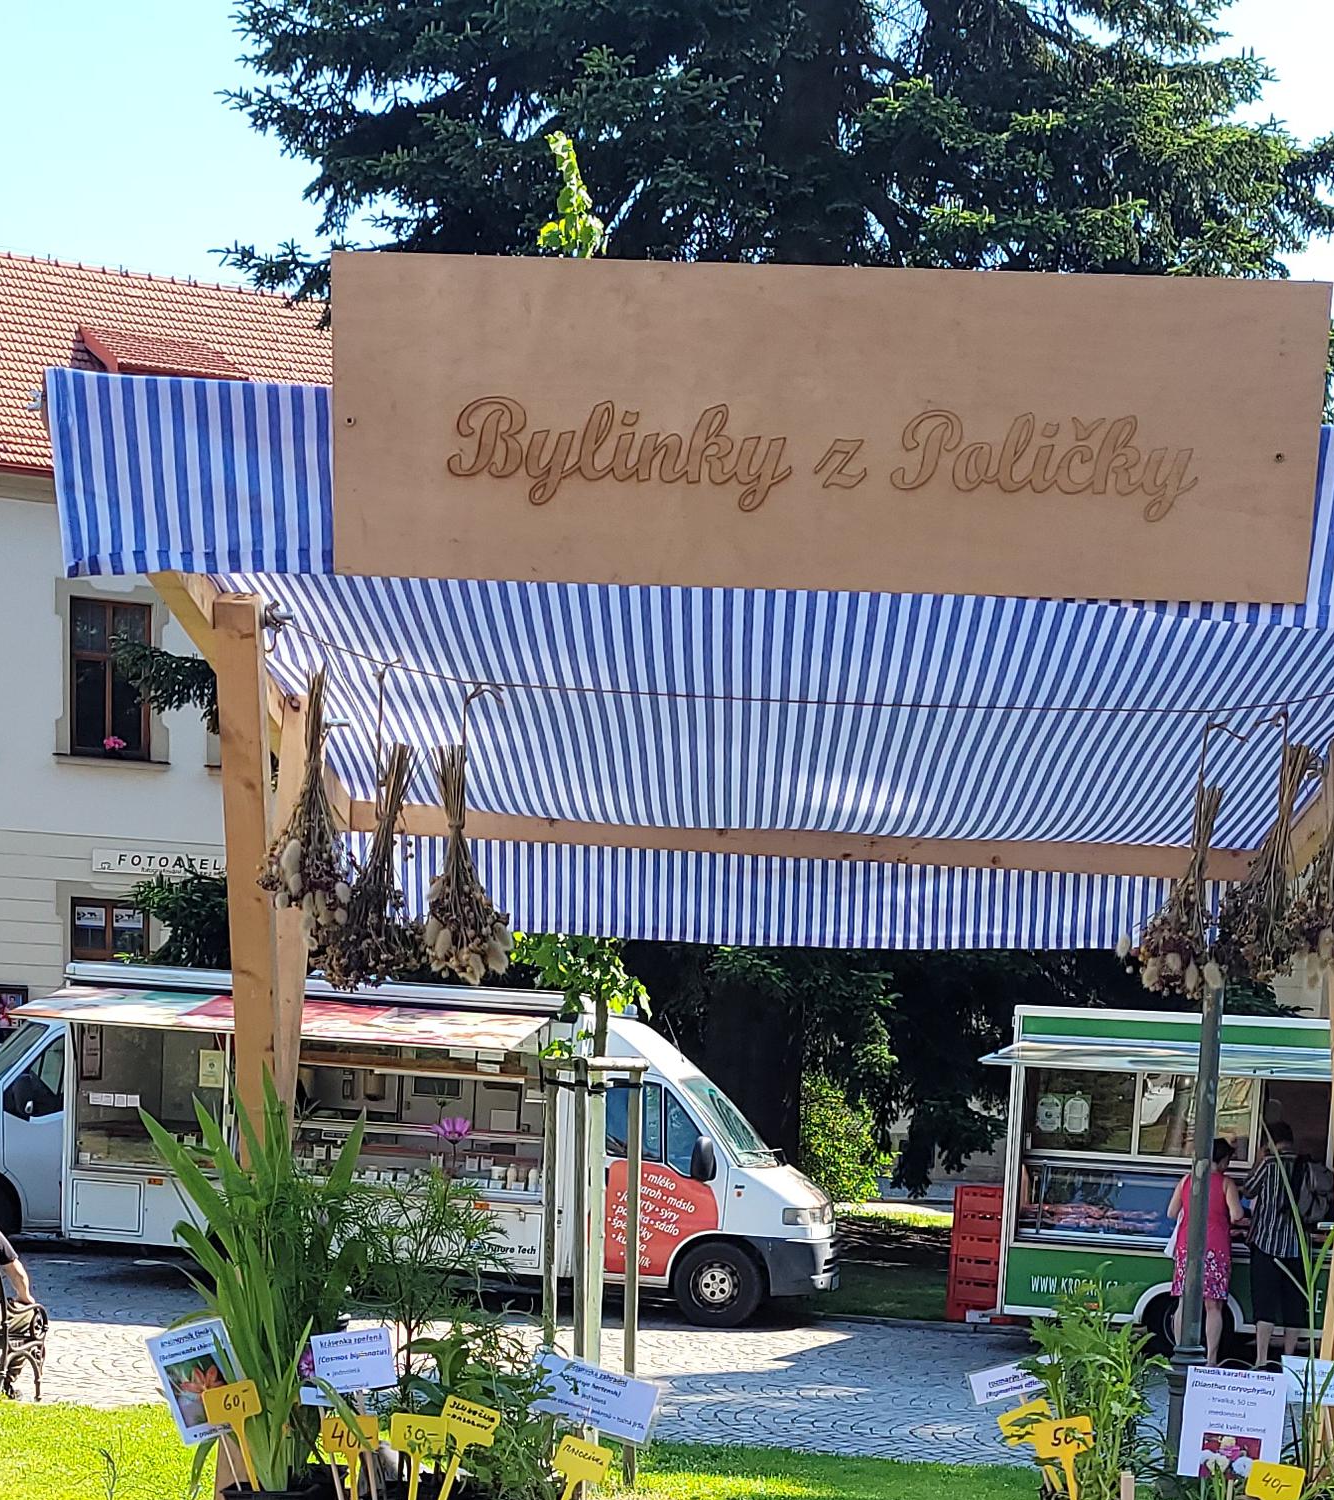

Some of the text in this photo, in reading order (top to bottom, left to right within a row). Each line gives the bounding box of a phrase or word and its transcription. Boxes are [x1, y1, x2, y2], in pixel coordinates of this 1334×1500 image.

[446, 395, 1202, 523] Bylinky z Poličky
[647, 1173, 676, 1190] mléko
[667, 1196, 695, 1213] máslo
[659, 1207, 679, 1223] sýry
[654, 1219, 679, 1237] sádlo
[517, 1245, 536, 1254] Tech
